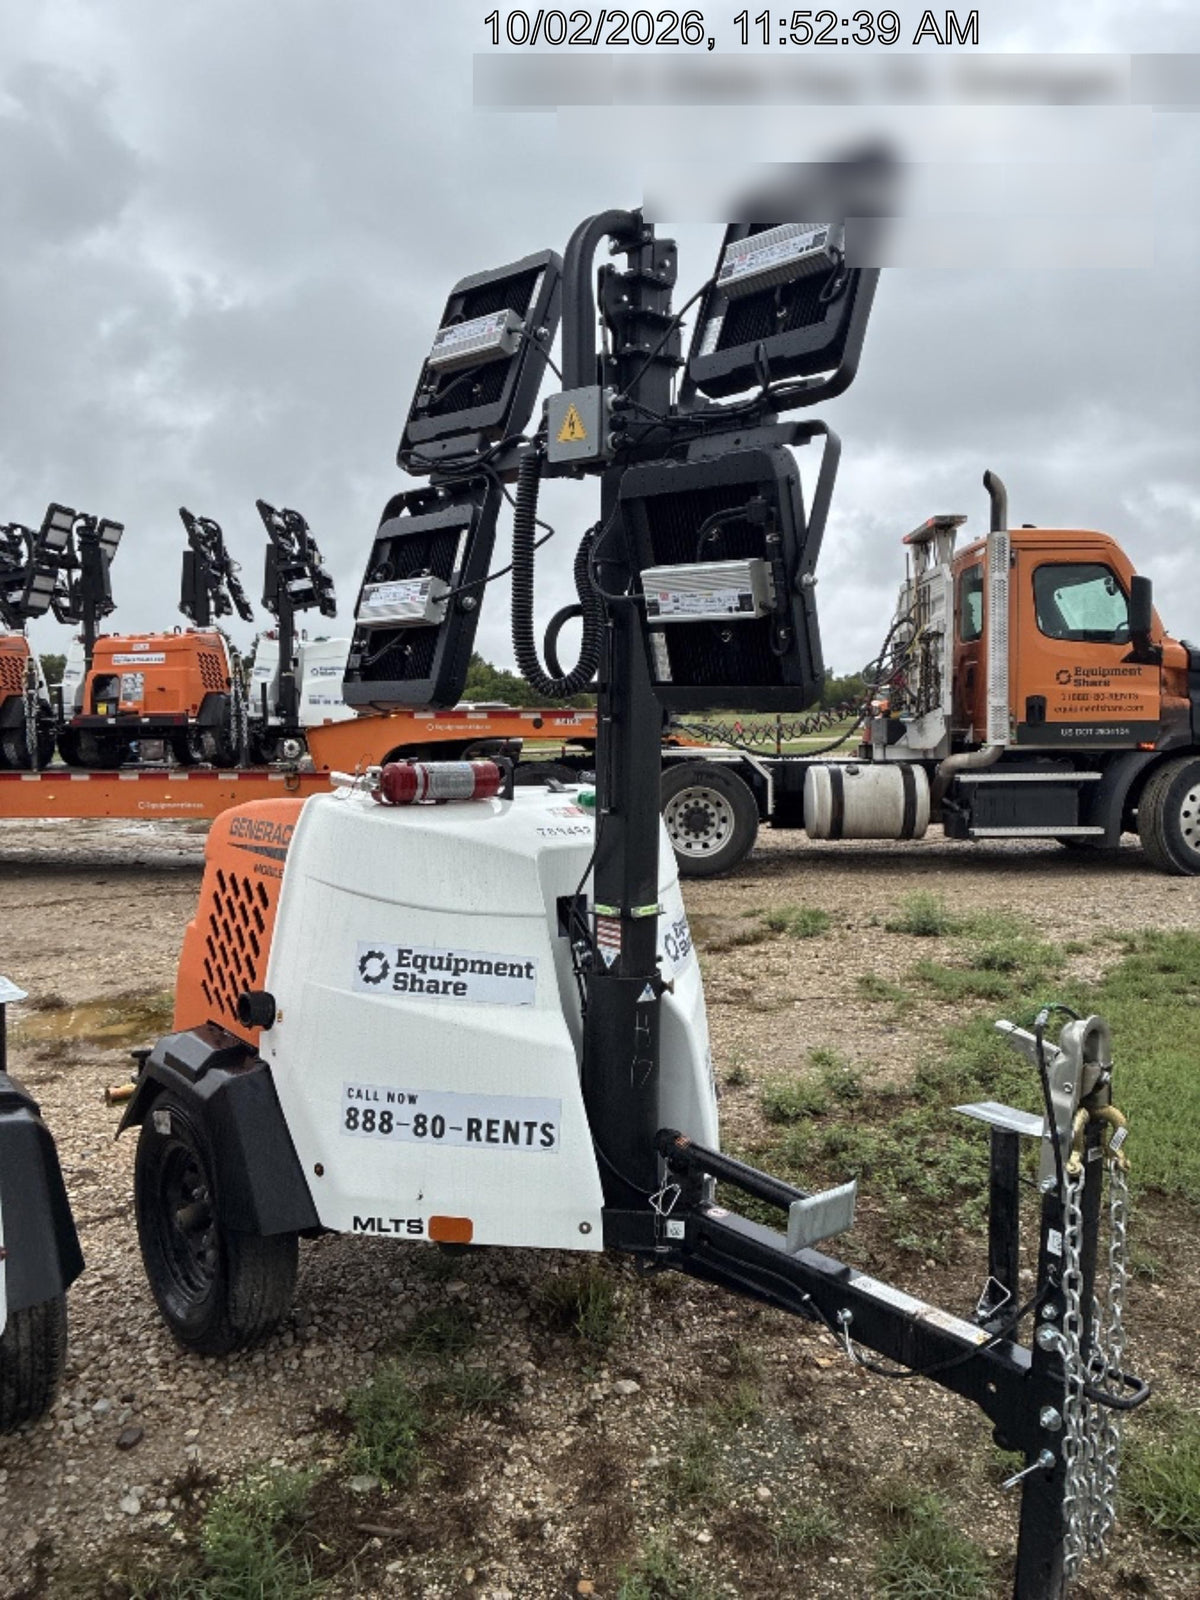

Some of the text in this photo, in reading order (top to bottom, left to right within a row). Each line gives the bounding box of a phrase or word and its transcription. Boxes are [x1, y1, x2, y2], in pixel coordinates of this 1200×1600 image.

[1073, 665, 1143, 678] Equipment
[1073, 678, 1111, 688] Share
[1060, 727, 1074, 737] US
[1075, 727, 1094, 737] DOT
[230, 816, 295, 846] GENERAC
[395, 948, 535, 980] Equipment
[392, 971, 468, 997] Share
[346, 1087, 419, 1105] CALL NOW
[344, 1106, 556, 1148] 888-80-RENTS
[353, 1215, 424, 1235] MLTS
